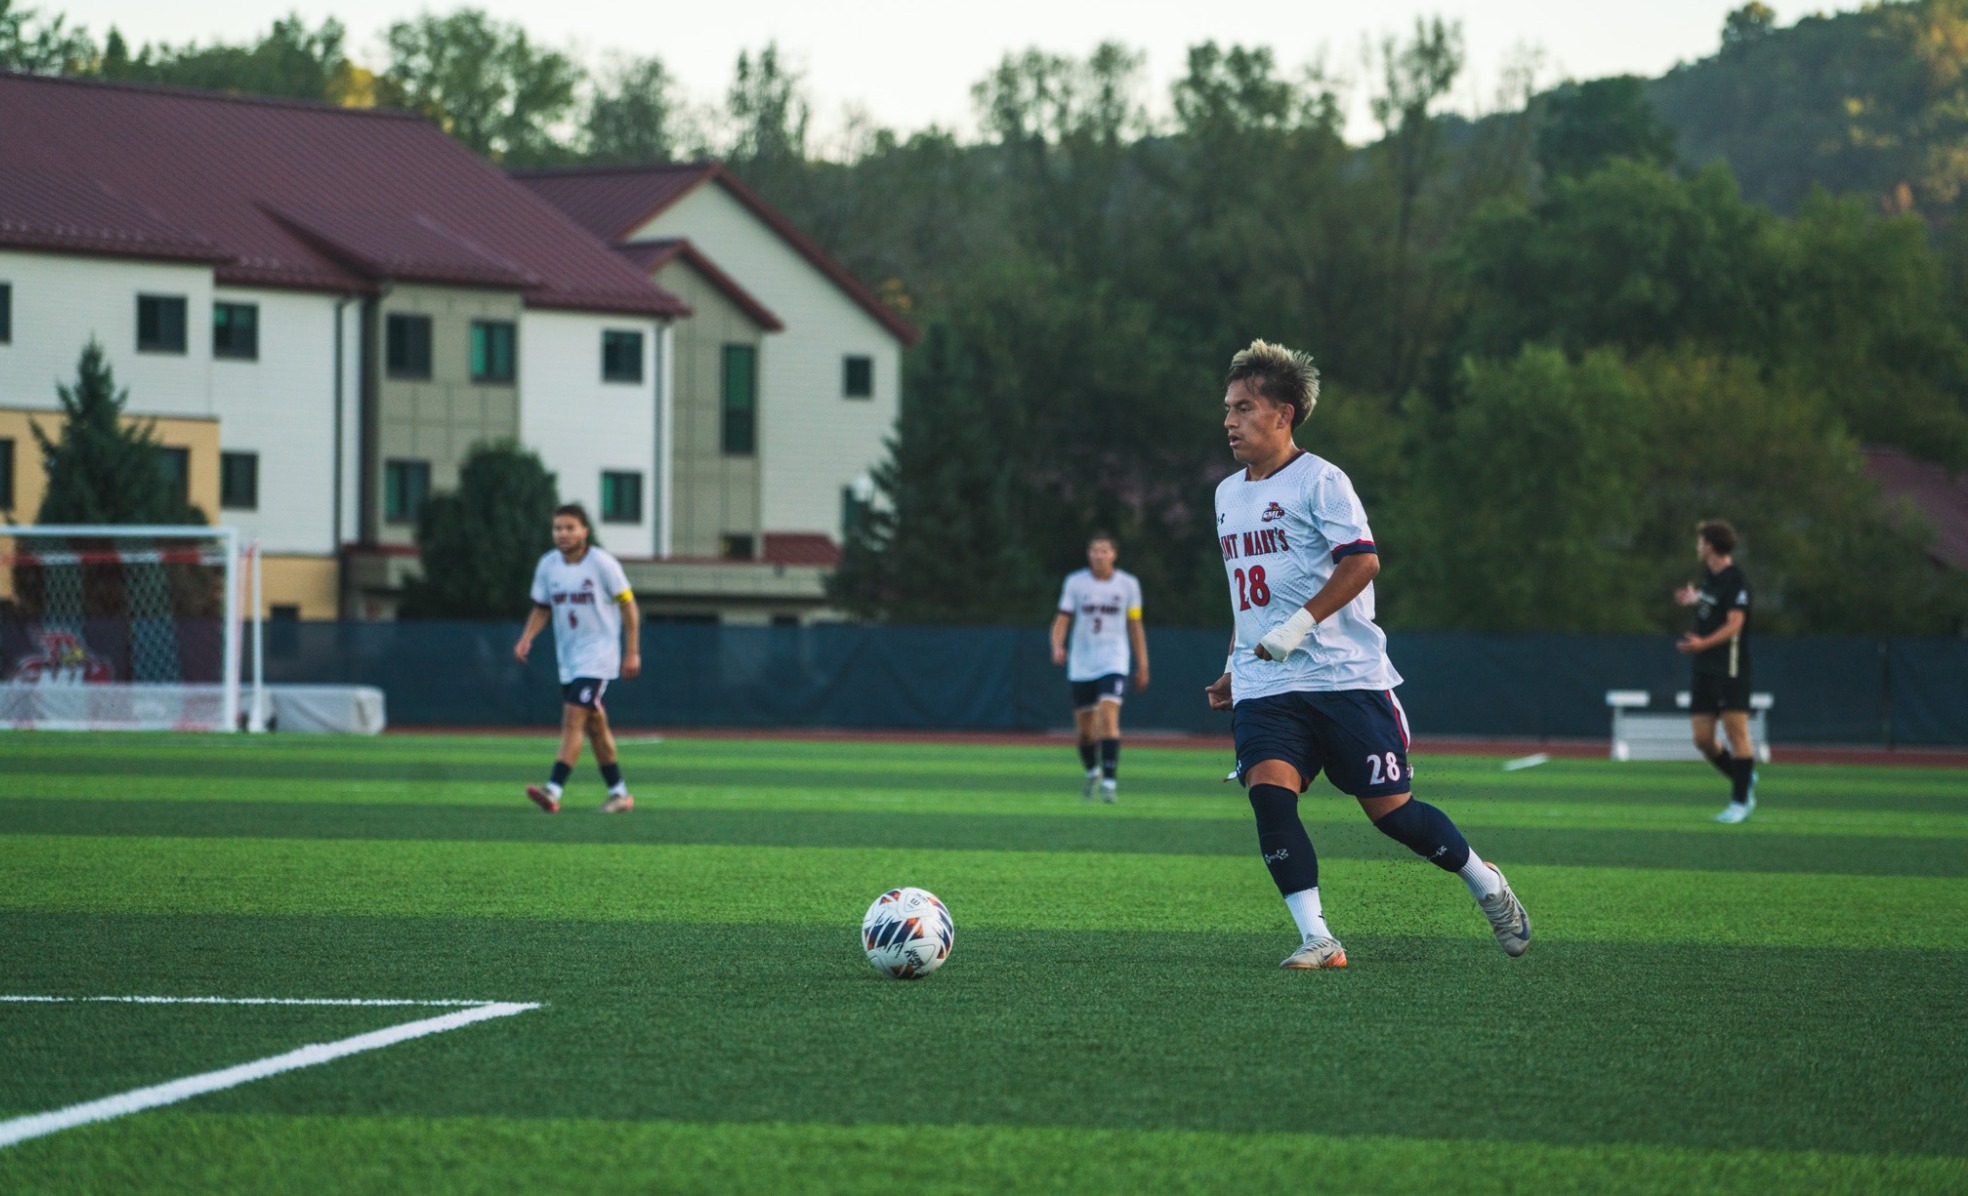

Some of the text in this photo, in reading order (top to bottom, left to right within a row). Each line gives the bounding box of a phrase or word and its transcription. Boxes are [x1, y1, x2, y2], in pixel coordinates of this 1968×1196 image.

[1220, 527, 1289, 561] INT MARY'S
[1234, 565, 1270, 611] 28
[580, 687, 592, 703] 6
[1367, 752, 1400, 785] 28
